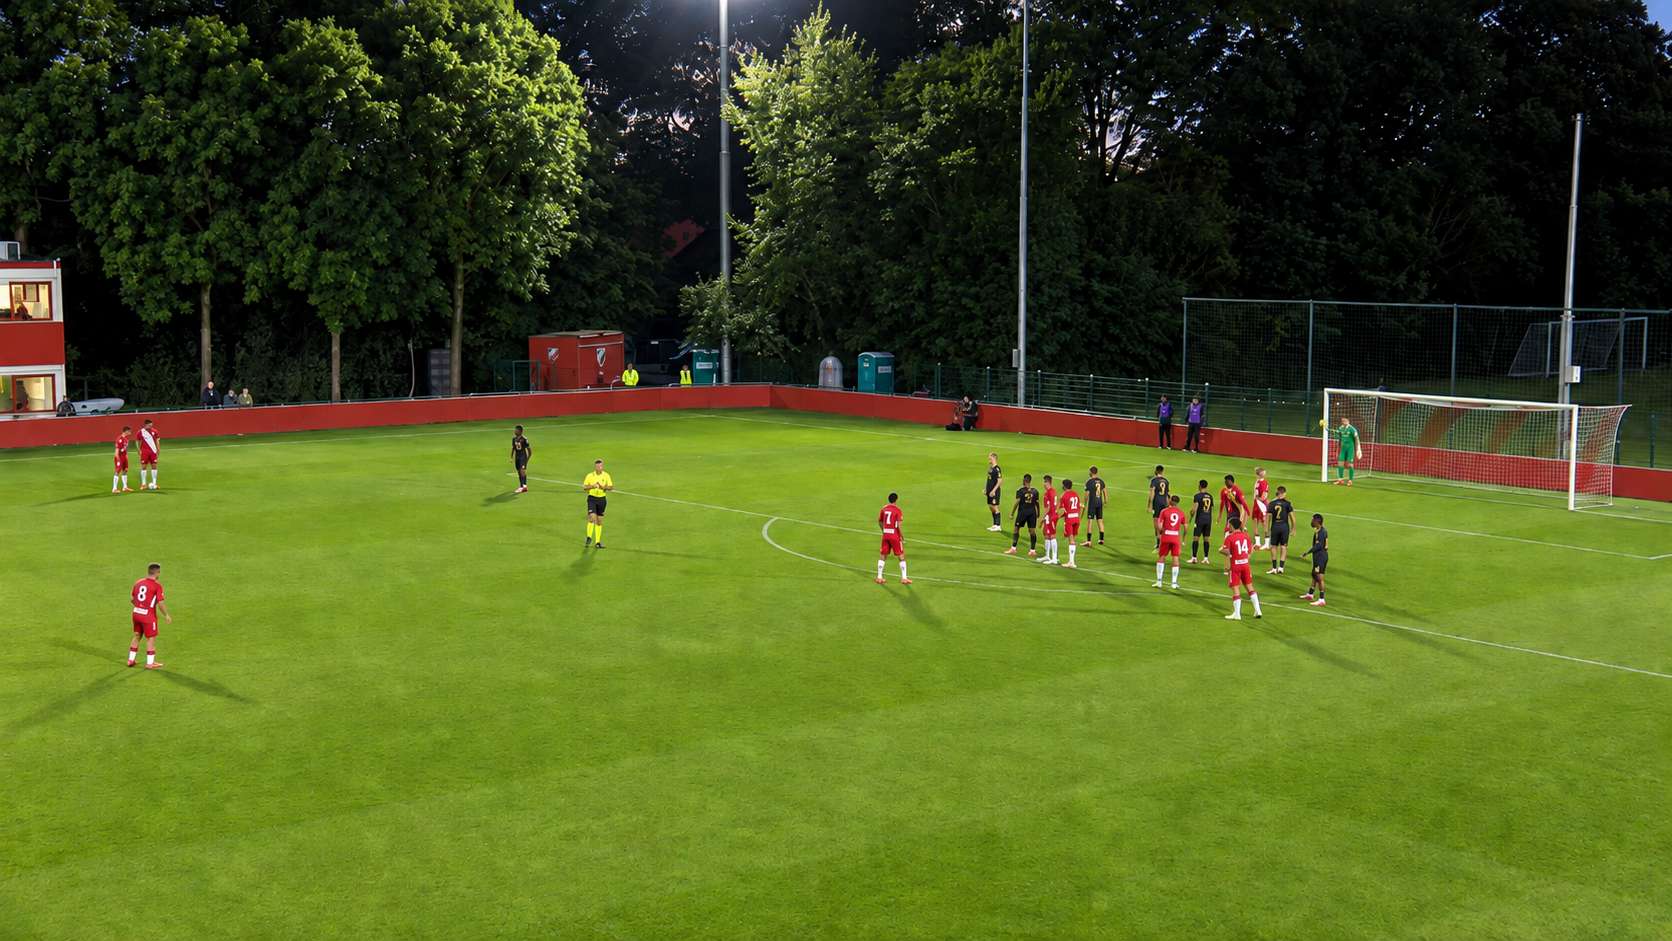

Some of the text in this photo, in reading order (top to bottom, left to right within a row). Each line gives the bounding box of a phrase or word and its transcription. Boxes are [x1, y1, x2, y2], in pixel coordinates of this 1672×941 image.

[884, 511, 892, 525] 7
[1170, 512, 1179, 527] 9
[1235, 539, 1249, 555] 14
[137, 585, 147, 602] 8
